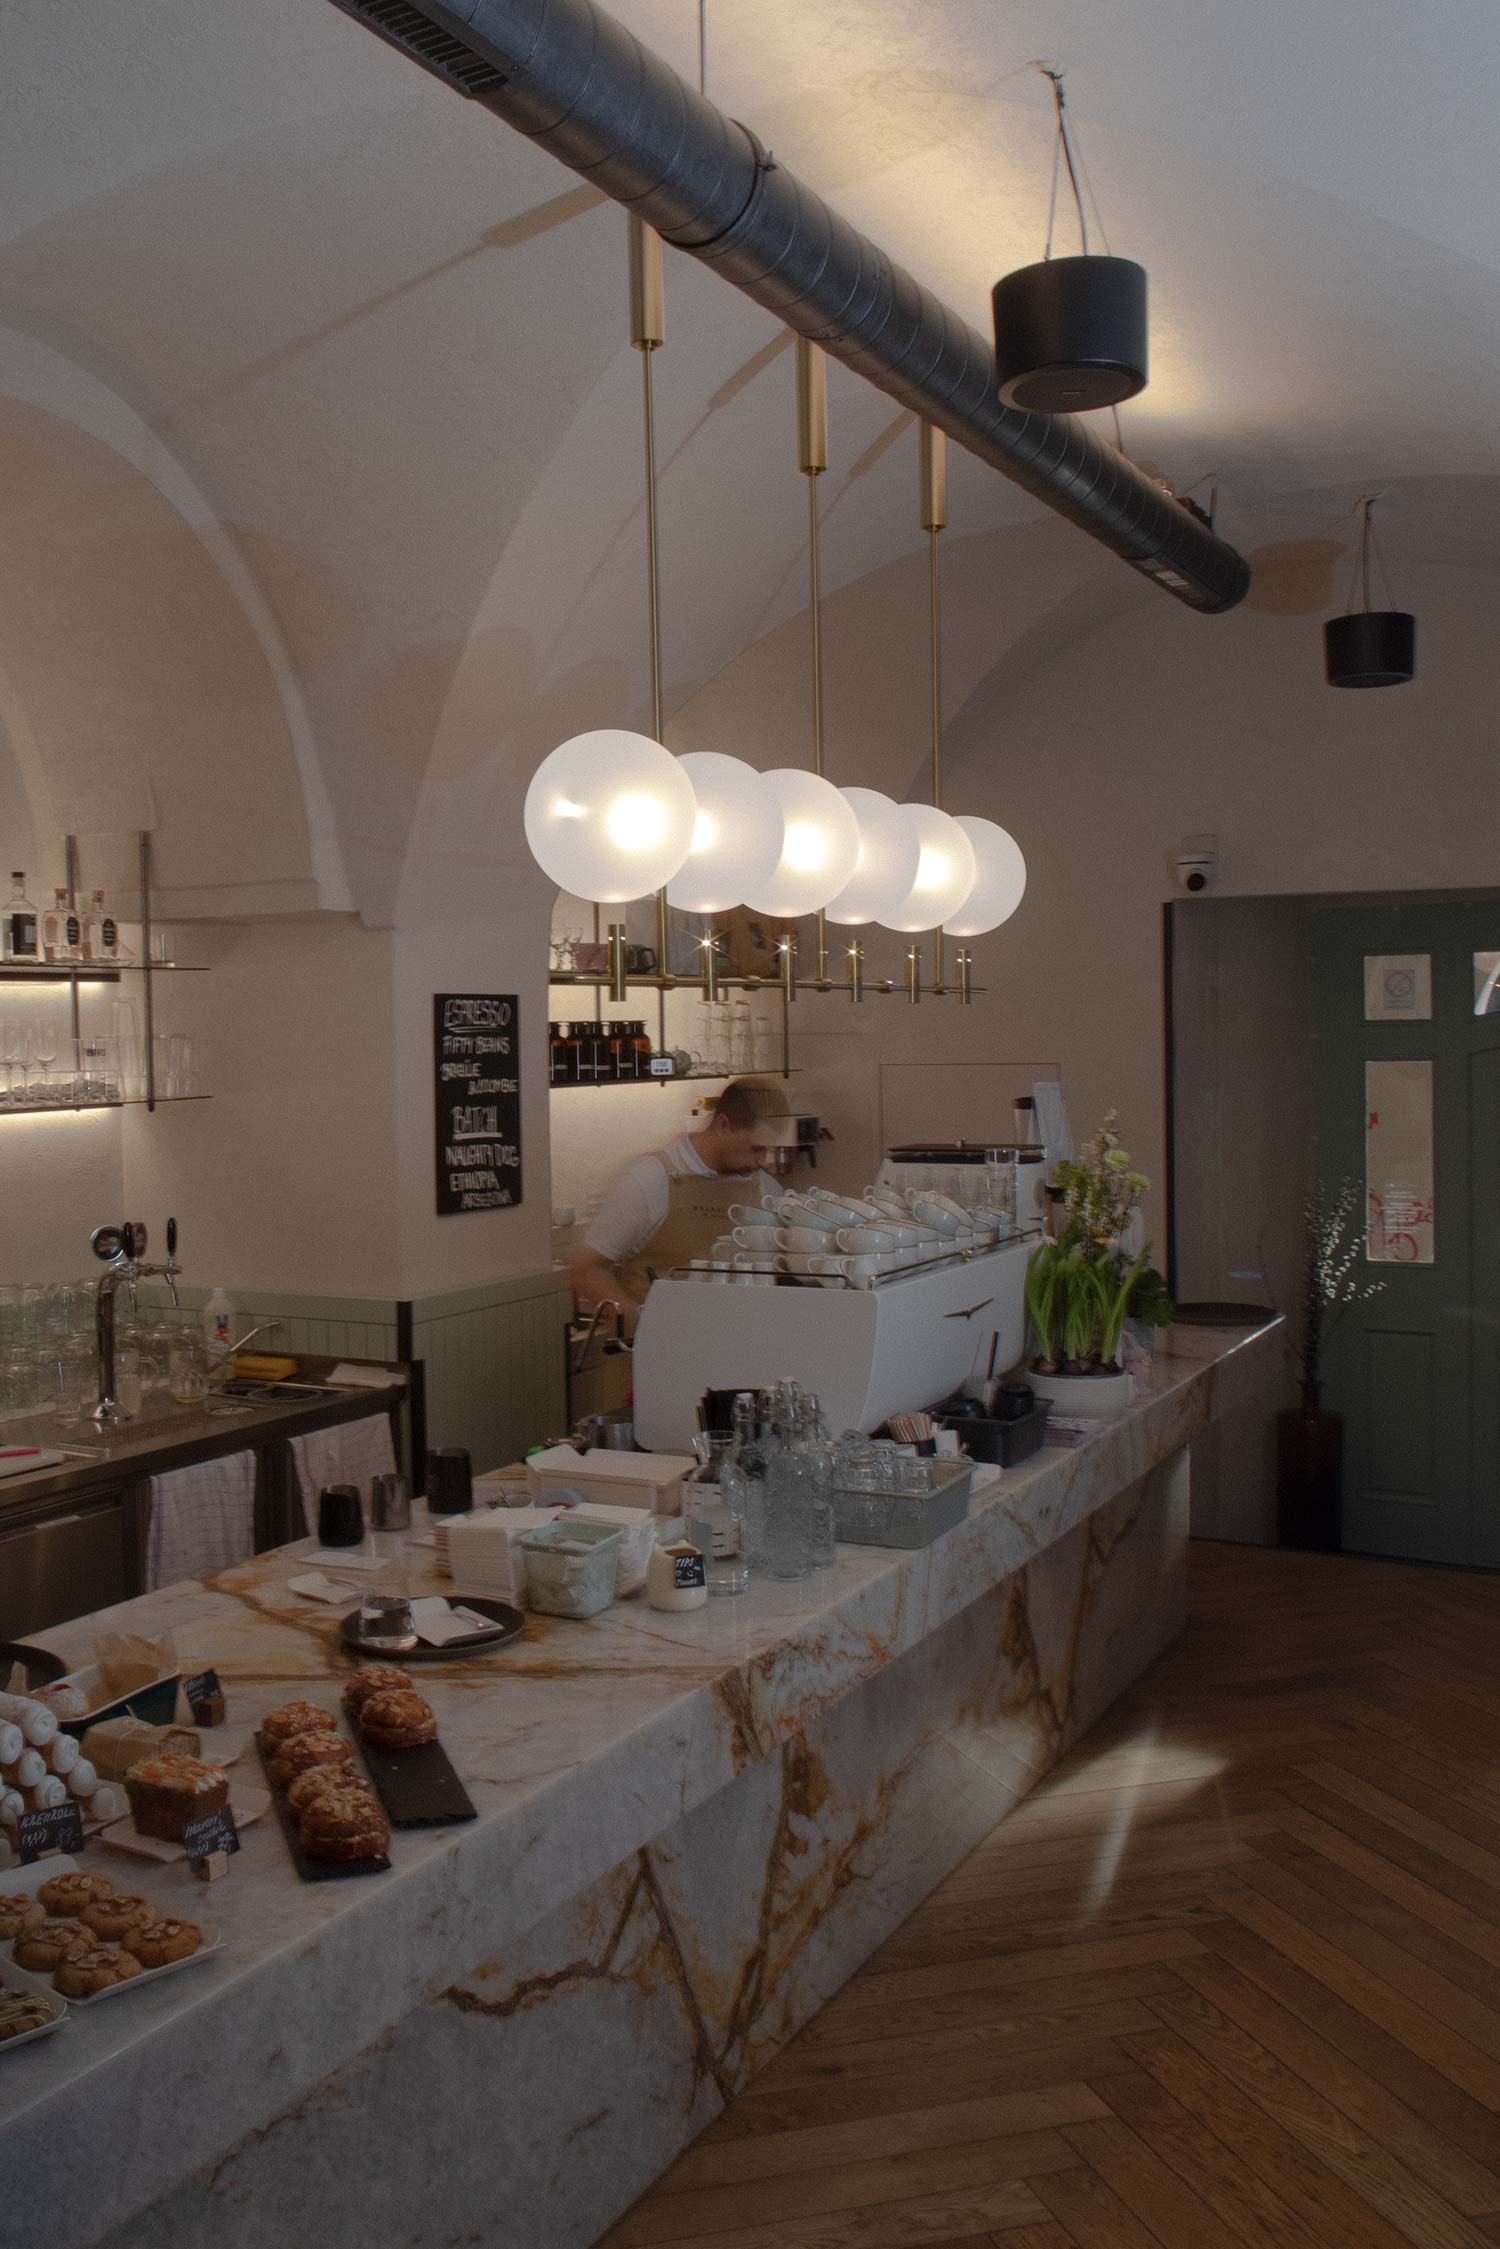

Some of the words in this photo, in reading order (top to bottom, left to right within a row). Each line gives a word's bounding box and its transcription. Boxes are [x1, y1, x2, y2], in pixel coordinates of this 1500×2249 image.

[444, 999, 511, 1027] ESPRESSO
[450, 1105, 498, 1133] BATCH
[445, 1145, 495, 1168] NAUGHTY
[494, 1143, 519, 1168] DOG
